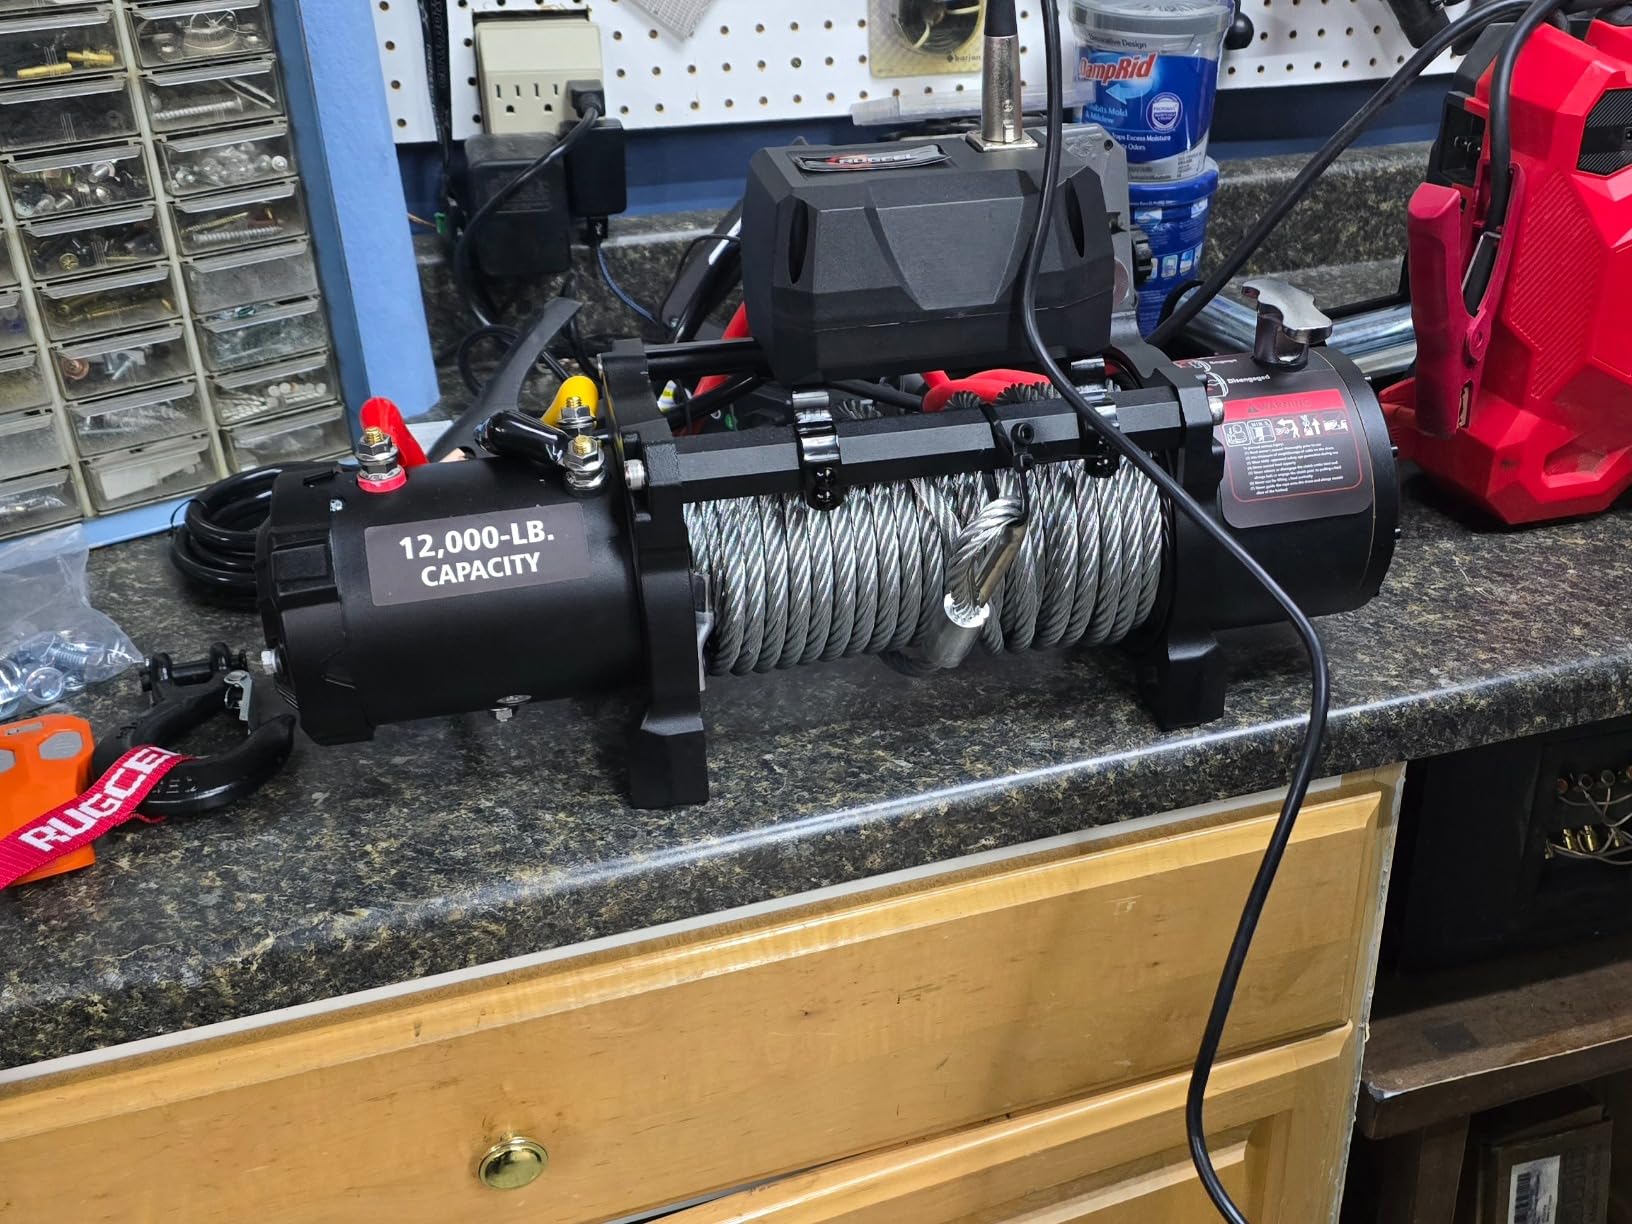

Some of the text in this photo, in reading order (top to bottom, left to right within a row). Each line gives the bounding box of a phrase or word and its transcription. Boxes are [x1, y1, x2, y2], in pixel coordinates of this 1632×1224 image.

[1121, 39, 1147, 49] Design
[1080, 52, 1157, 85] DampRid
[399, 520, 554, 560] 12,000-LB.
[421, 552, 540, 587] CAPACITY
